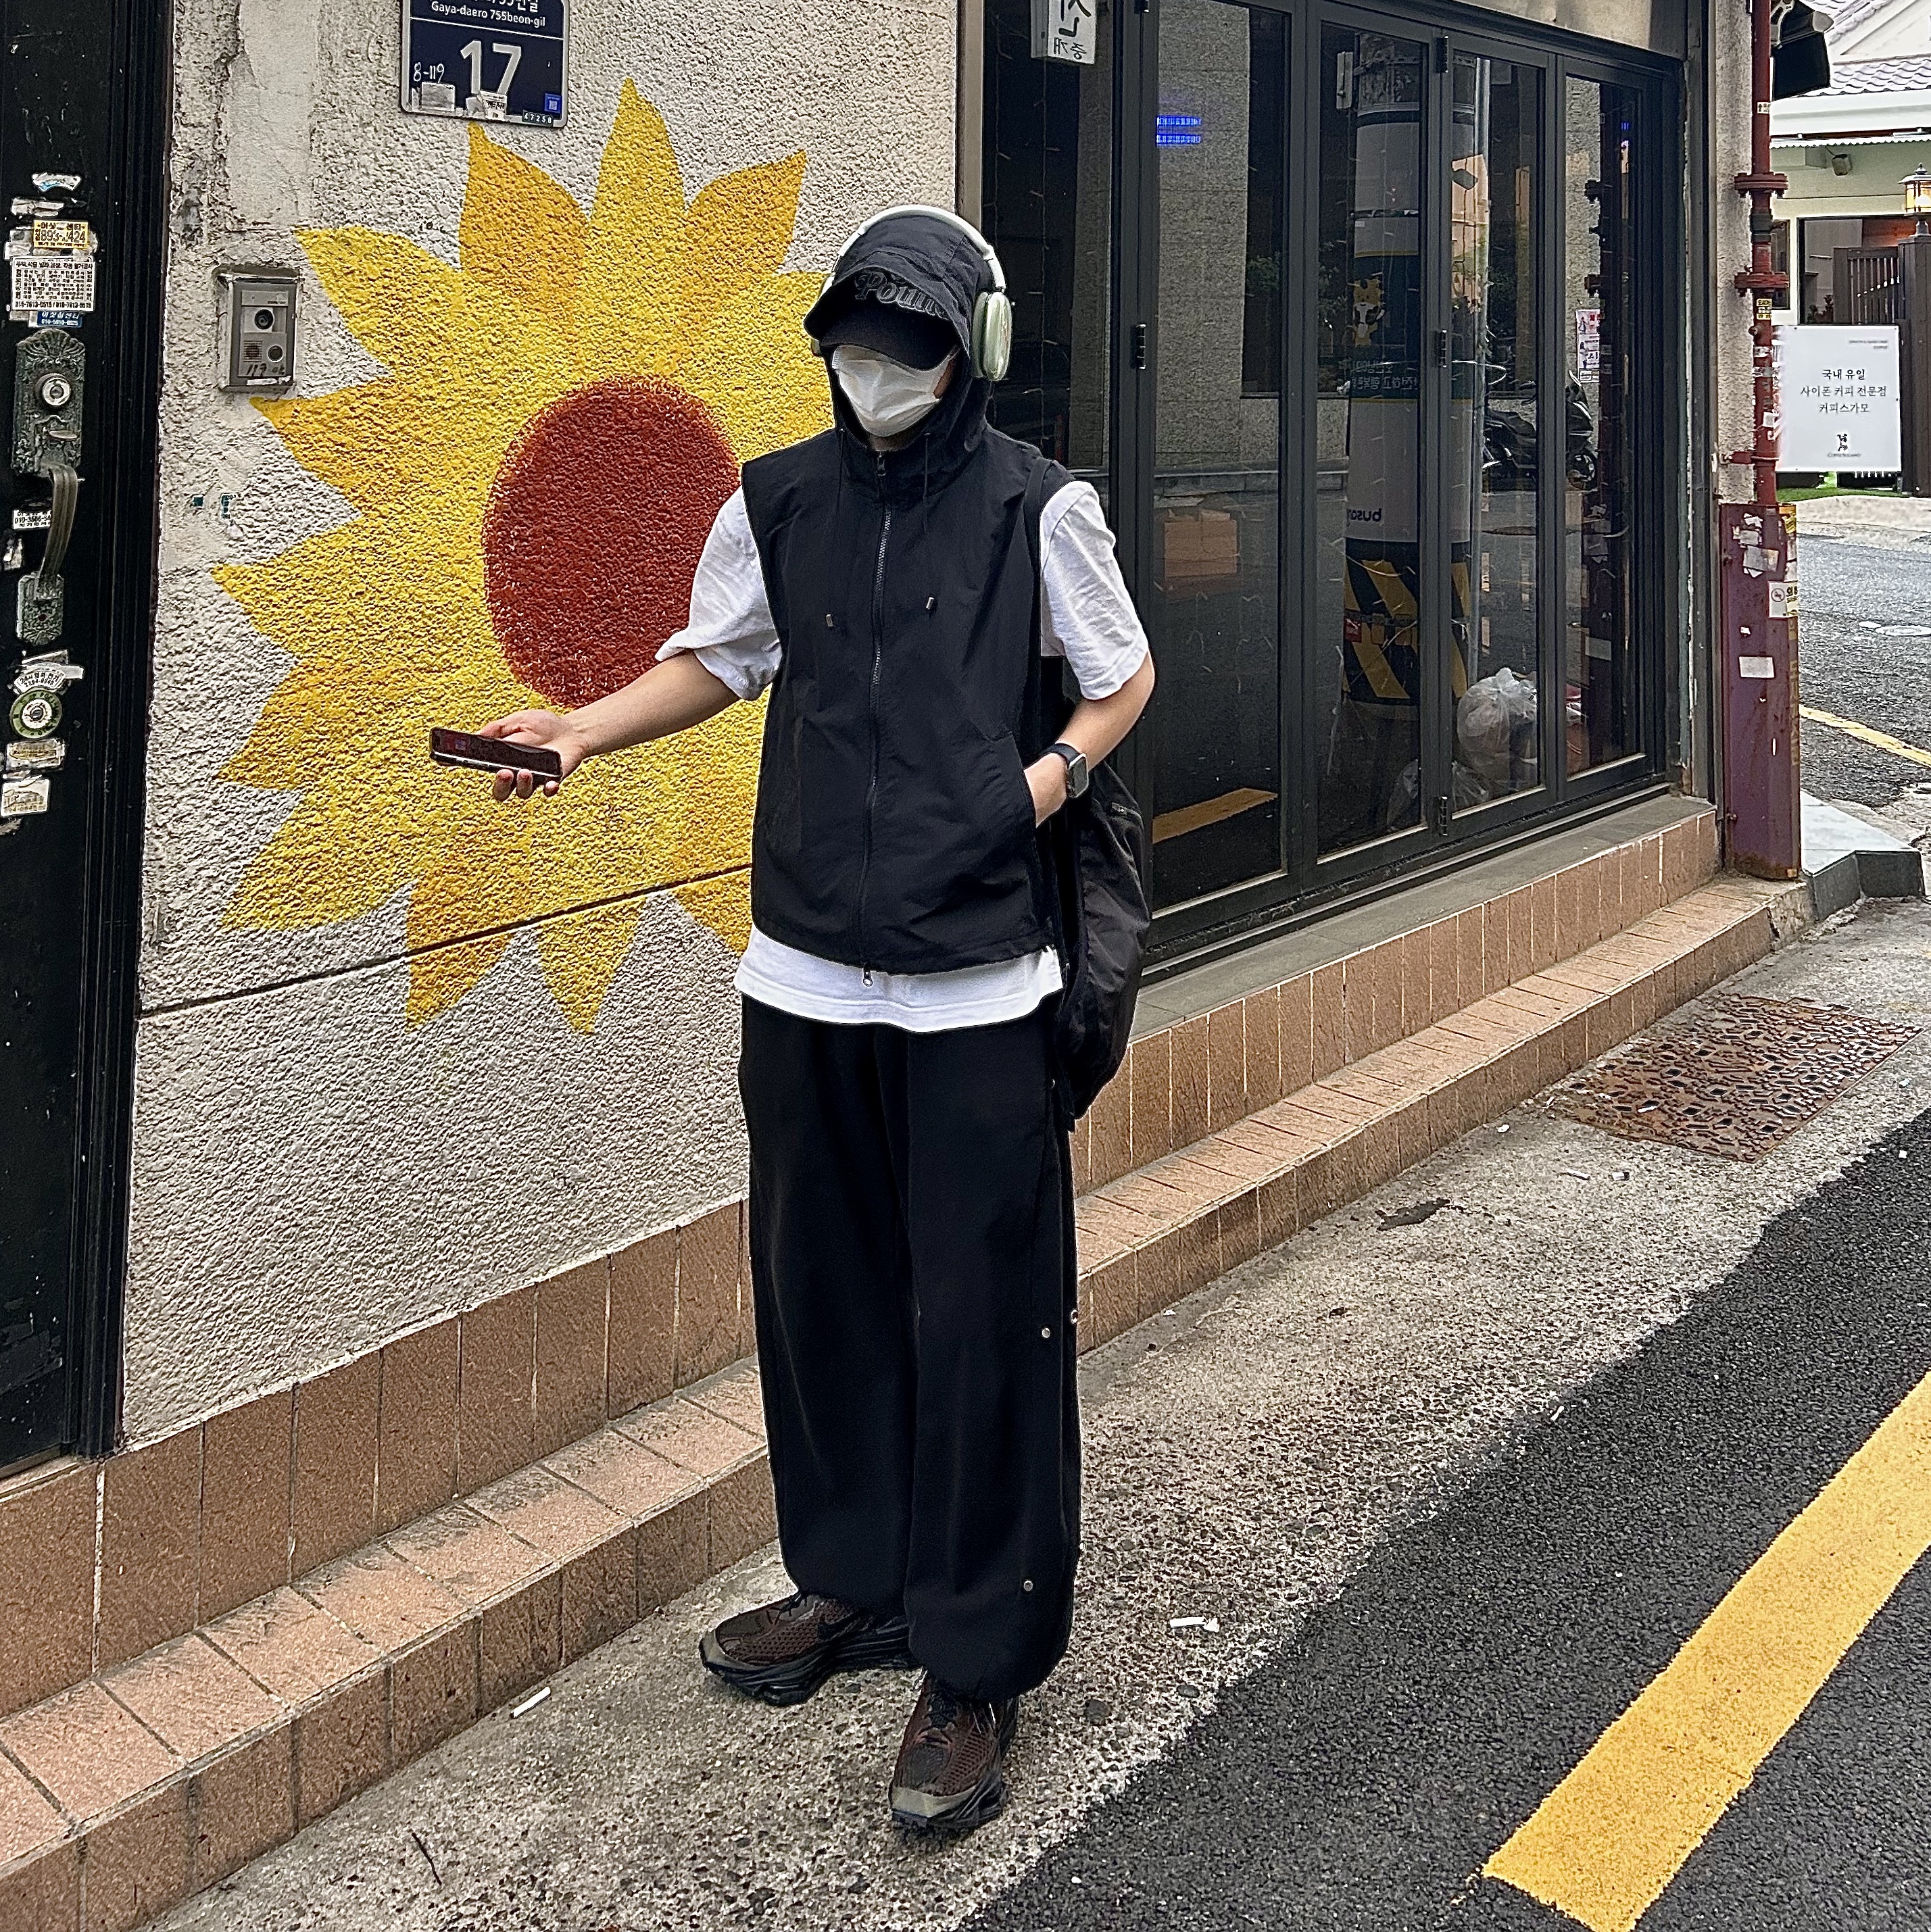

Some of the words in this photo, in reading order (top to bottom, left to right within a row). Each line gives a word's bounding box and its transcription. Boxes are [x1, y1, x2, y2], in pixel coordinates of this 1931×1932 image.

[431, 1, 487, 18] Gaya-daero
[490, 9, 545, 28] 755beon-gil
[413, 62, 445, 82] 8-119
[460, 40, 522, 95] 17
[524, 113, 552, 124] 47258
[1822, 369, 1842, 380] 국내
[1845, 369, 1865, 380] 유일
[1800, 385, 1831, 397] 사이폰
[1834, 385, 1853, 397] 커피
[1857, 385, 1886, 397] 전문점
[1819, 403, 1870, 414] 커피스가모
